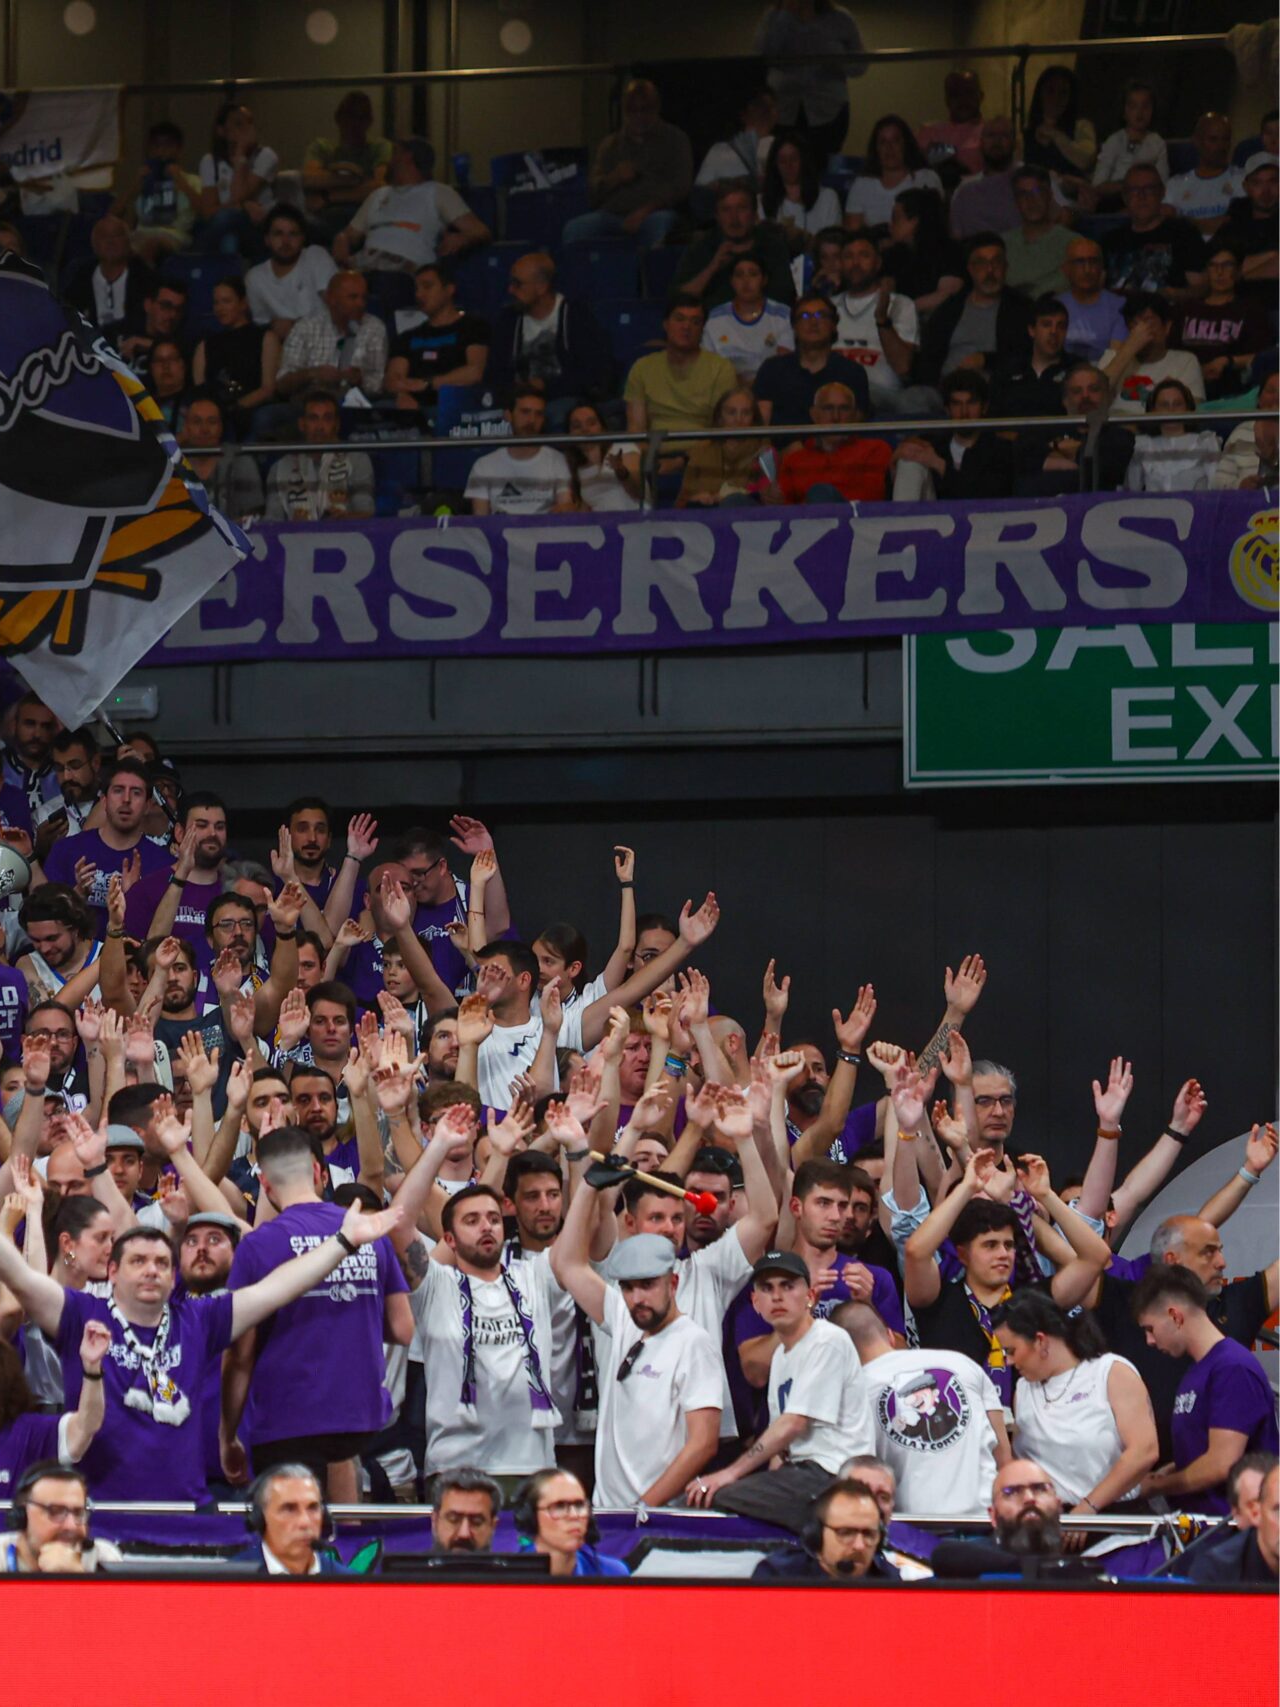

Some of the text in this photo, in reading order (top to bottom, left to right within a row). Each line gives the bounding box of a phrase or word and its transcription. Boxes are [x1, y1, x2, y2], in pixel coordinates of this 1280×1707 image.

[0, 138, 62, 167] adrid
[1182, 316, 1244, 342] ARLEY
[163, 496, 1190, 650] ERSERKERS
